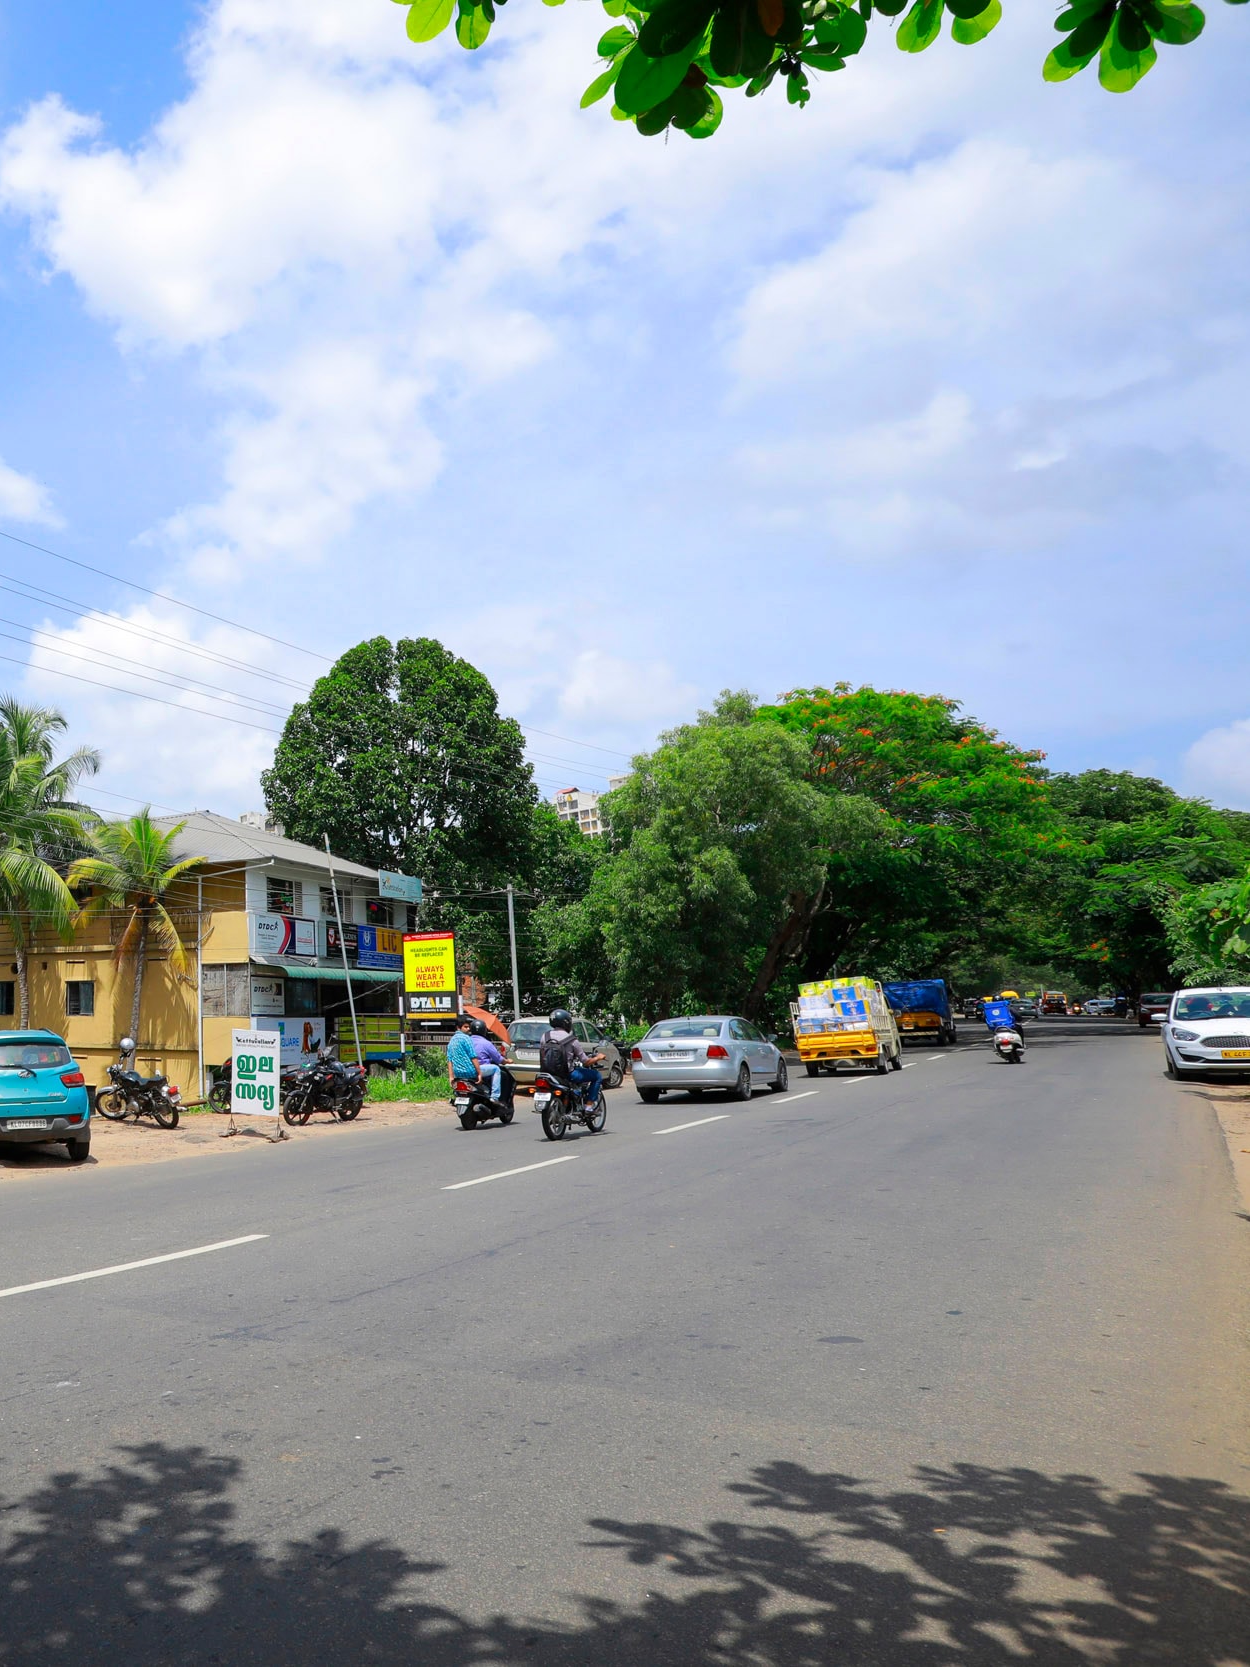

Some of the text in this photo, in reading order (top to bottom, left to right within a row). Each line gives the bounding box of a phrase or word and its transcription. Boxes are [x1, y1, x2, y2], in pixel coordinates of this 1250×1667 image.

[382, 931, 397, 952] LIC
[415, 965, 445, 973] ALWAYS
[416, 973, 437, 981] WEAR
[416, 980, 445, 989] HELMET
[410, 996, 452, 1009] DTALE
[237, 1054, 274, 1080] ഇല
[235, 1082, 275, 1111] സദ്യ
